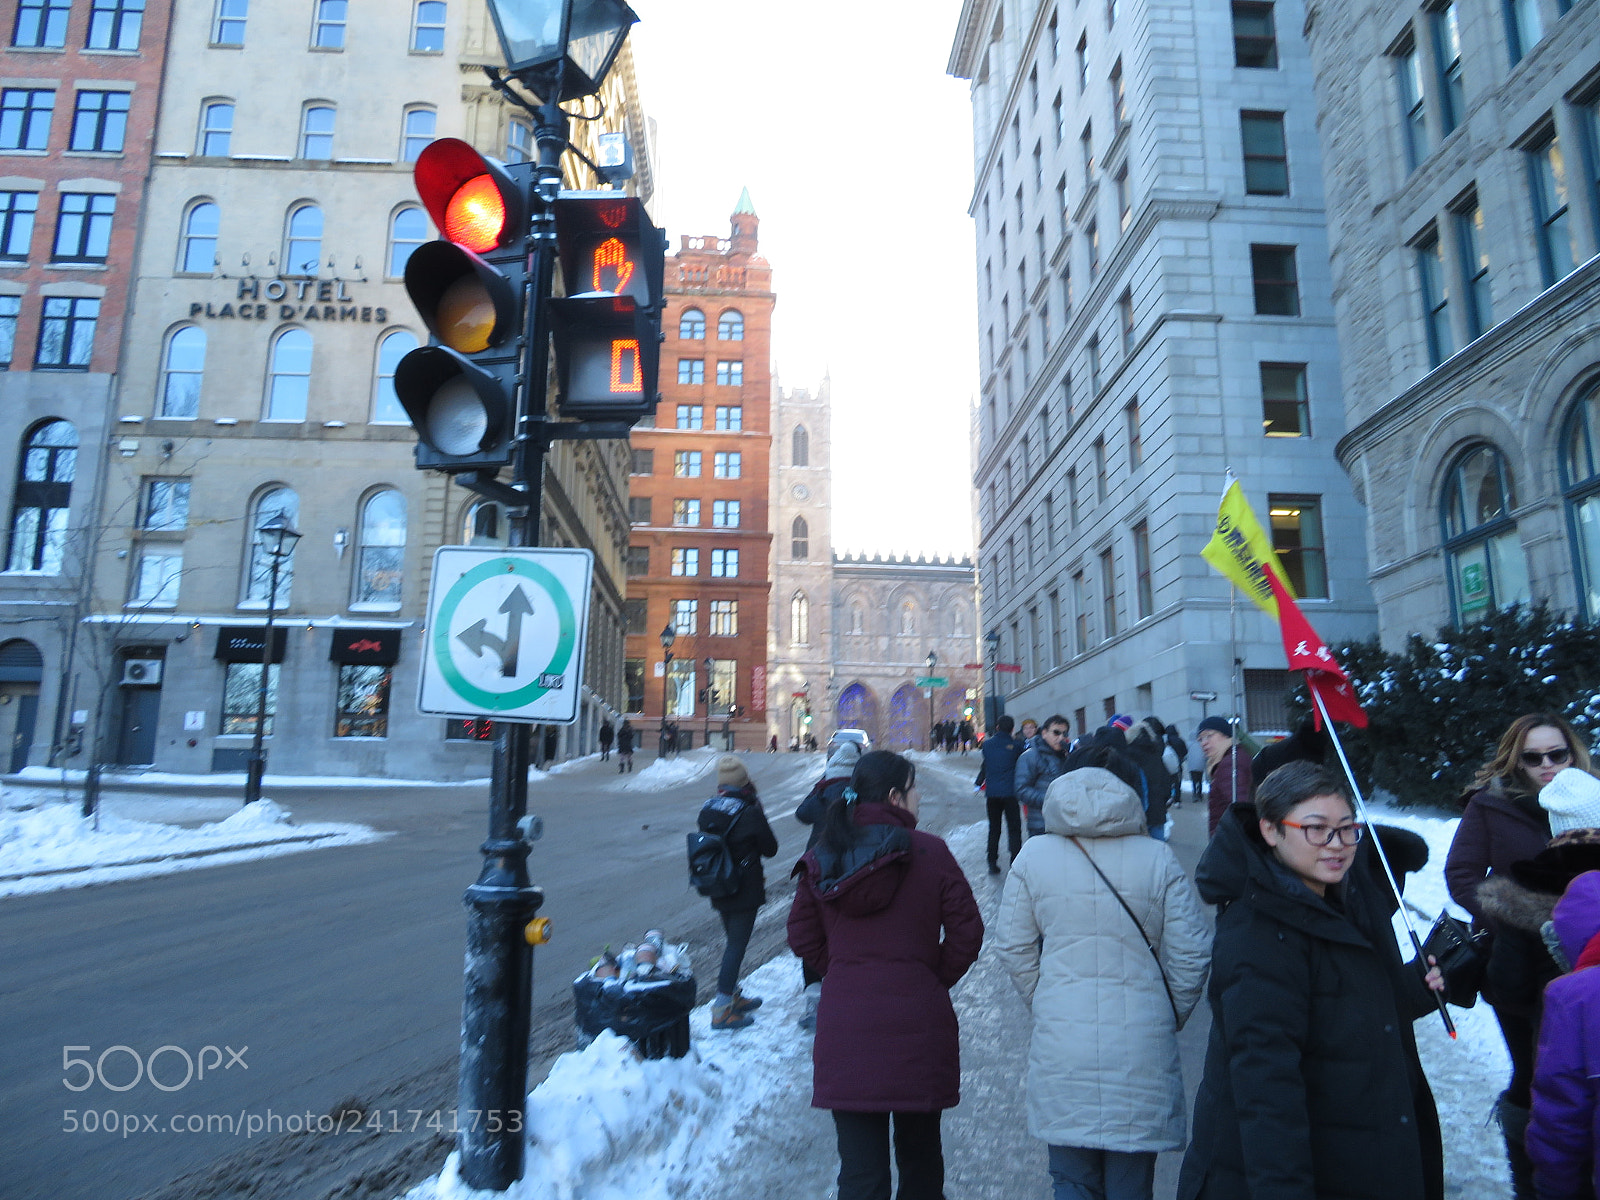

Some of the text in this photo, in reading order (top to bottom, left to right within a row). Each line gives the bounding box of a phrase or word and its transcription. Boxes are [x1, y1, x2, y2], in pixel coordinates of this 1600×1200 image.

[237, 278, 352, 302] HOTEL
[190, 302, 388, 323] PLACE D'ARMES
